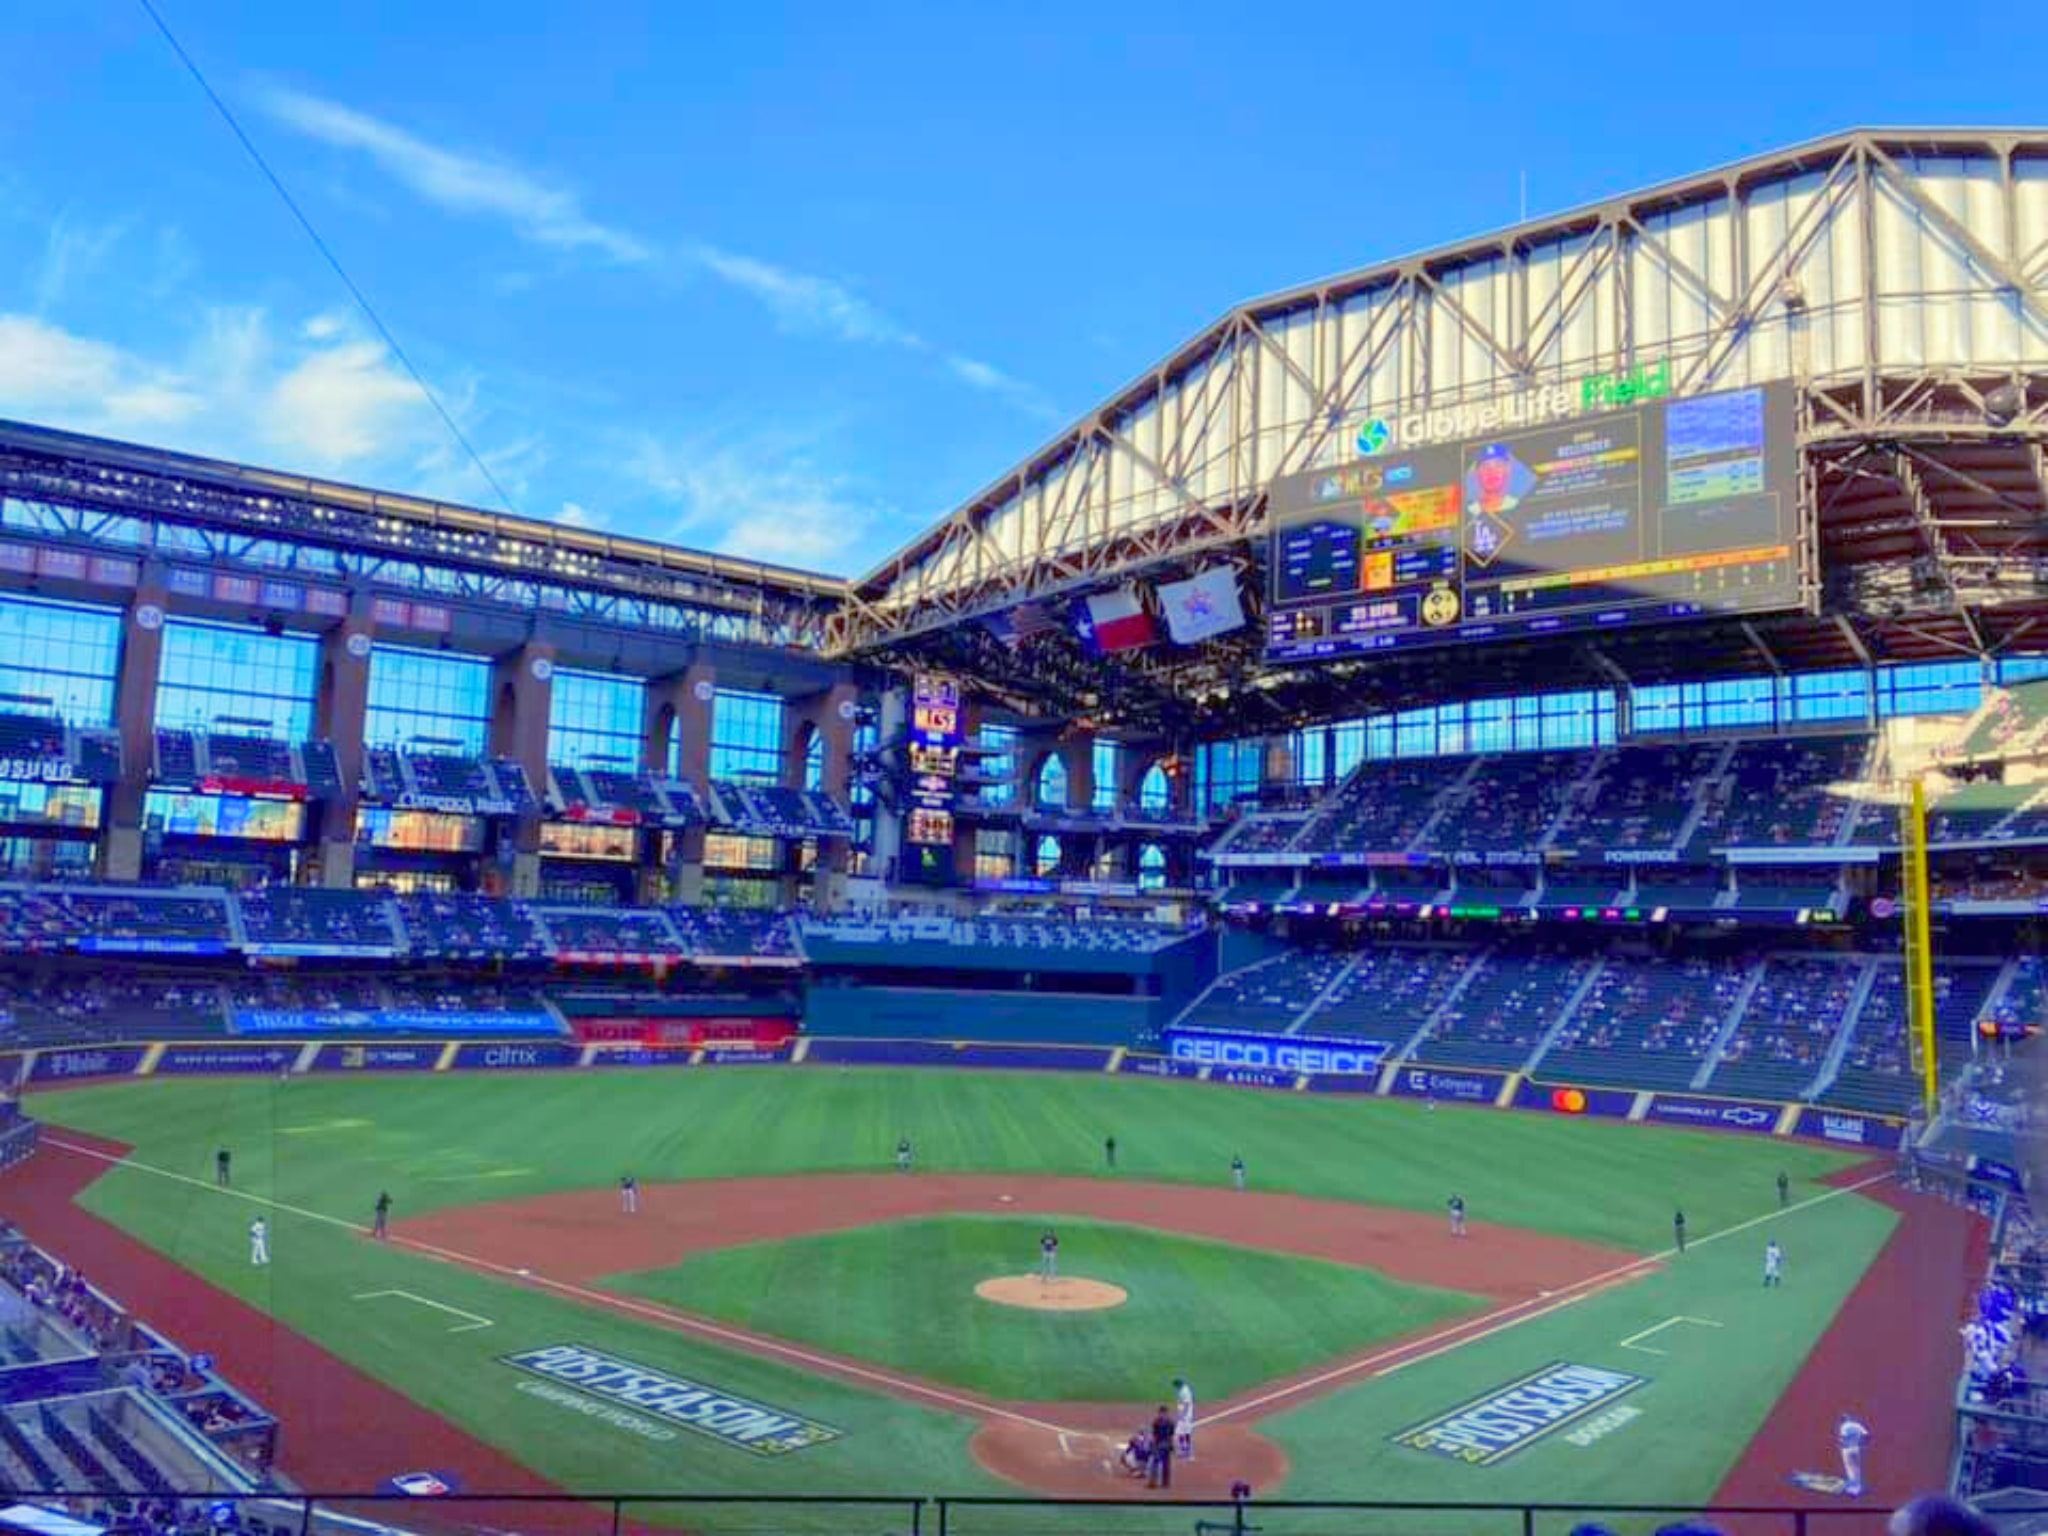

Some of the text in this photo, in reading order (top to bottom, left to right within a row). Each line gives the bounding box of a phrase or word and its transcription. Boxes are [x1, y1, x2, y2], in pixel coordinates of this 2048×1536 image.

[1402, 357, 1671, 444] Globe Life Field
[485, 1046, 537, 1066] citrix
[1173, 1037, 1381, 1075] GEICO GEICO
